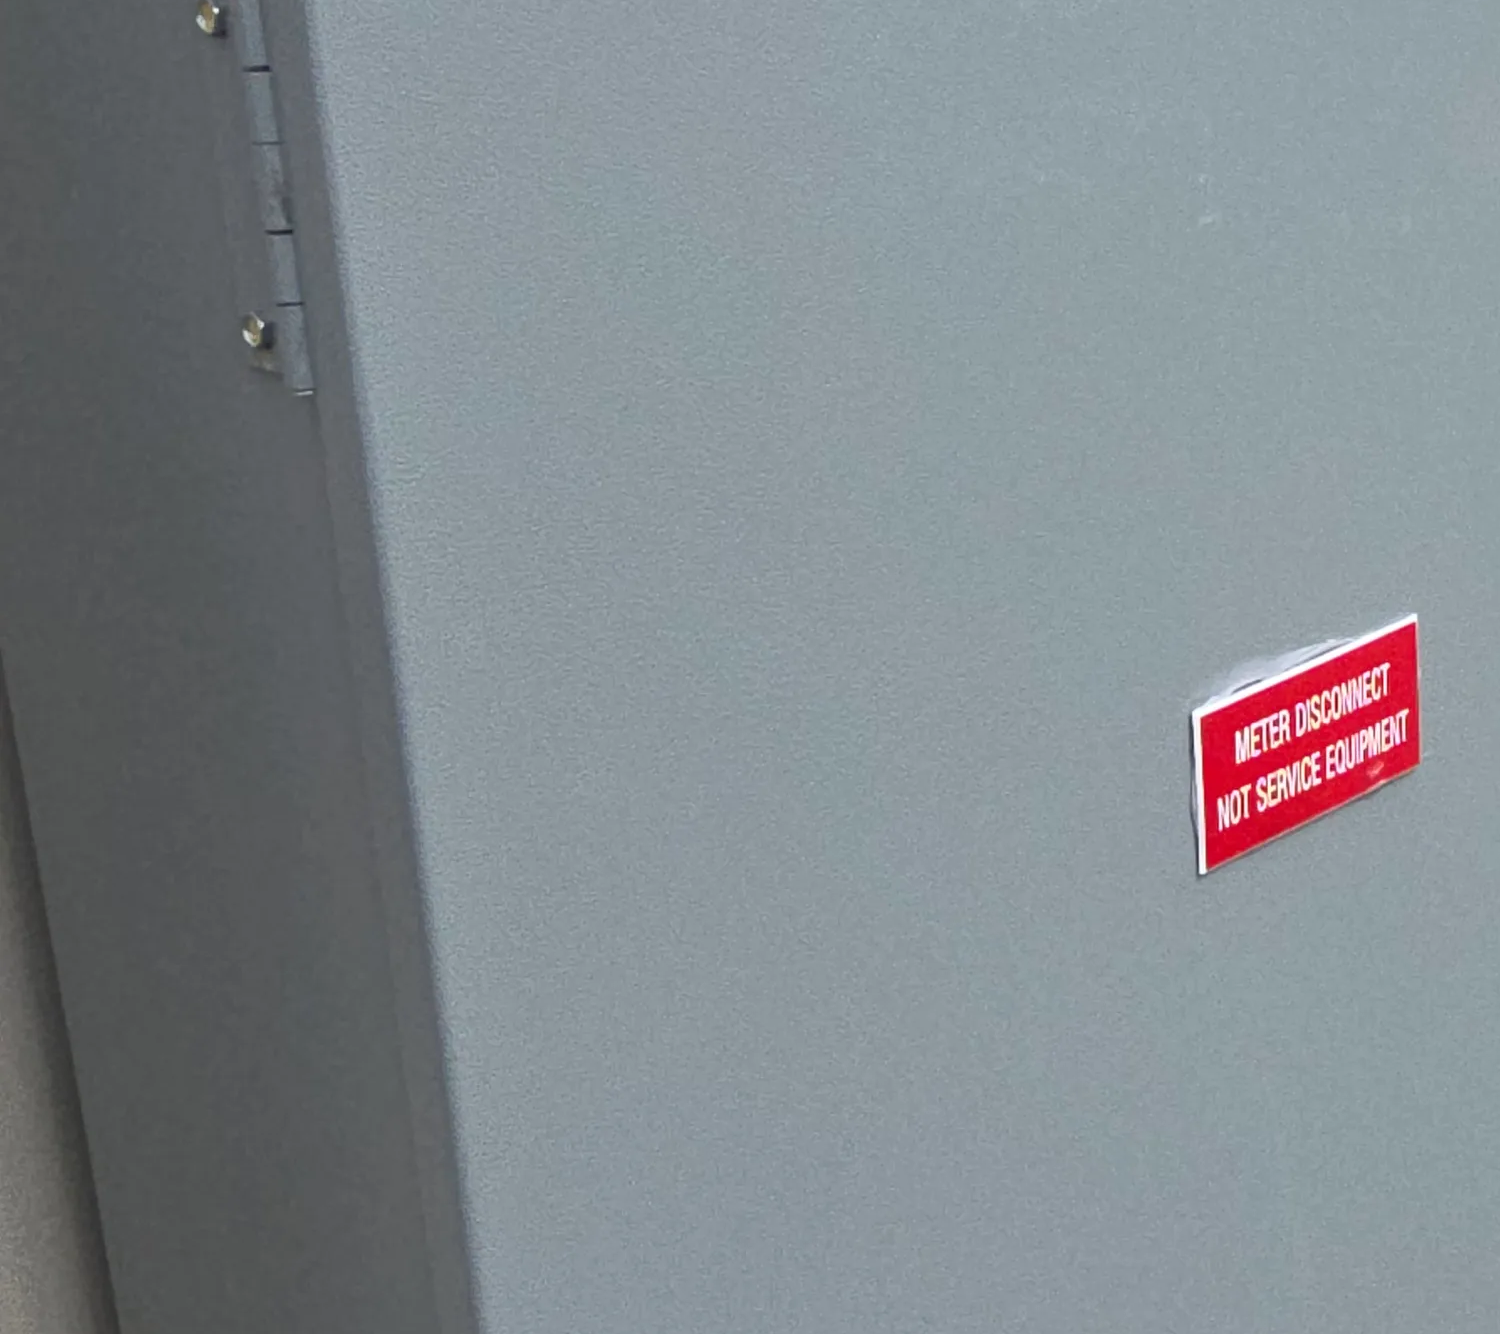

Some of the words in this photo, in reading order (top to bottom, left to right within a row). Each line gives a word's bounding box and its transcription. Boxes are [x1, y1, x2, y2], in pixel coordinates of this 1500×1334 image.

[1217, 783, 1252, 832] NOT
[1255, 752, 1322, 813] SERVICE
[1326, 708, 1409, 779] EQUIPMENT
[1234, 709, 1291, 765] METER
[1295, 662, 1391, 738] DISCONNECT
